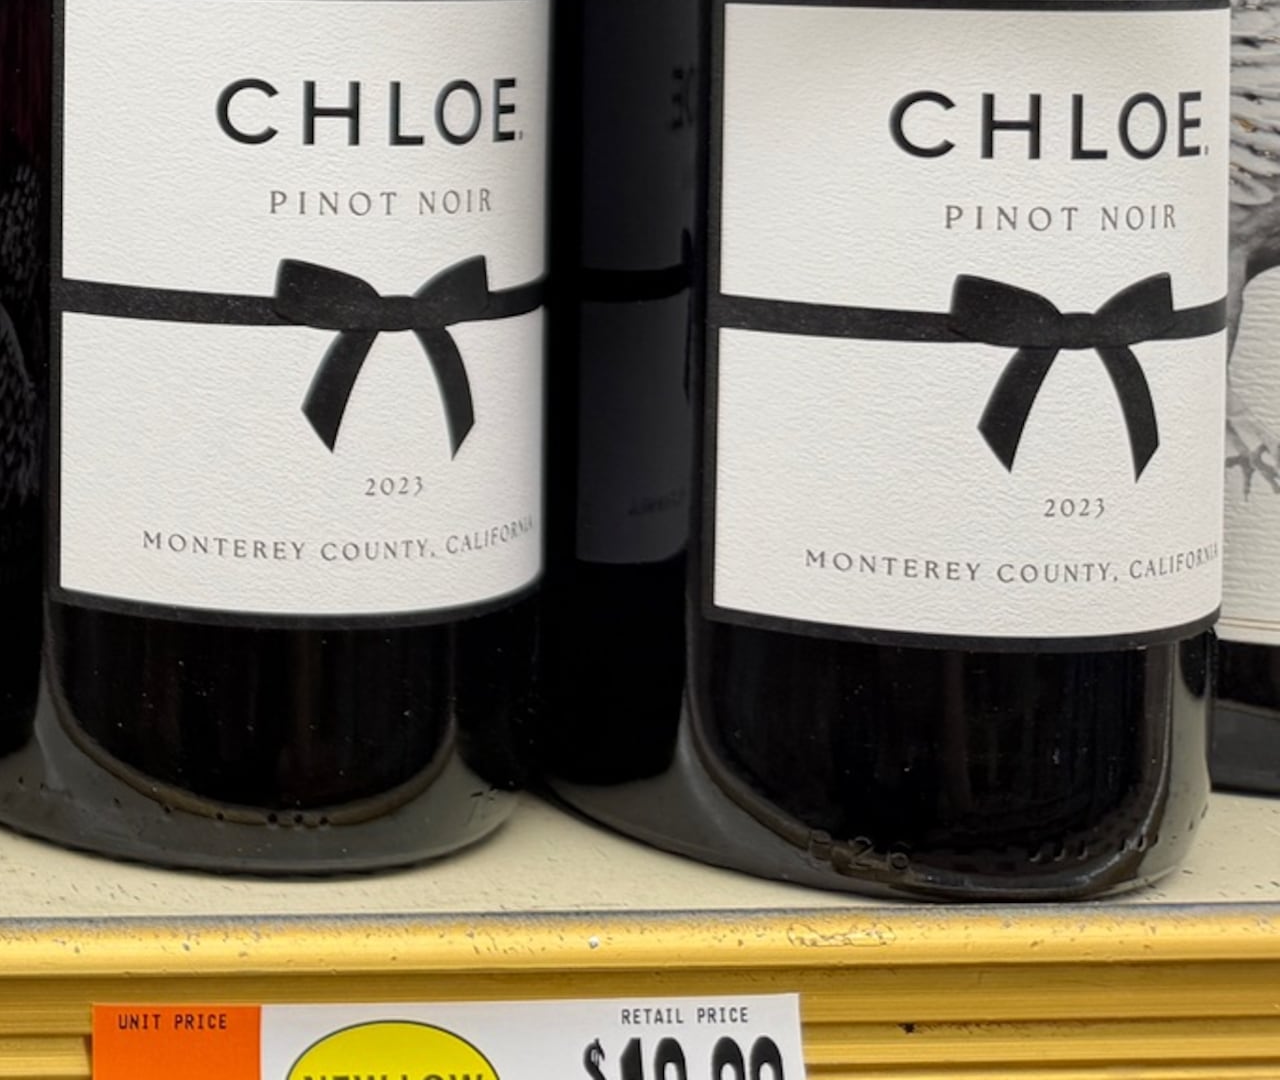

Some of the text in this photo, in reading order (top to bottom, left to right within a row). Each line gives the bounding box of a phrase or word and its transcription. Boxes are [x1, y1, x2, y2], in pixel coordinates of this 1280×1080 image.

[216, 77, 519, 147] CHLOE
[889, 89, 1204, 161] CHLOE
[270, 188, 493, 217] PINOT NOIR
[944, 203, 1177, 232] PINOT NOIR
[364, 474, 425, 497] 2023
[1043, 496, 1107, 520] 2023
[143, 530, 305, 562] MONTEREY
[805, 549, 981, 584] MONTEREY
[996, 562, 1118, 585] COUNTY,
[118, 1013, 228, 1031] UNIT PRICE
[621, 1006, 750, 1025] RETAIL PRICE
